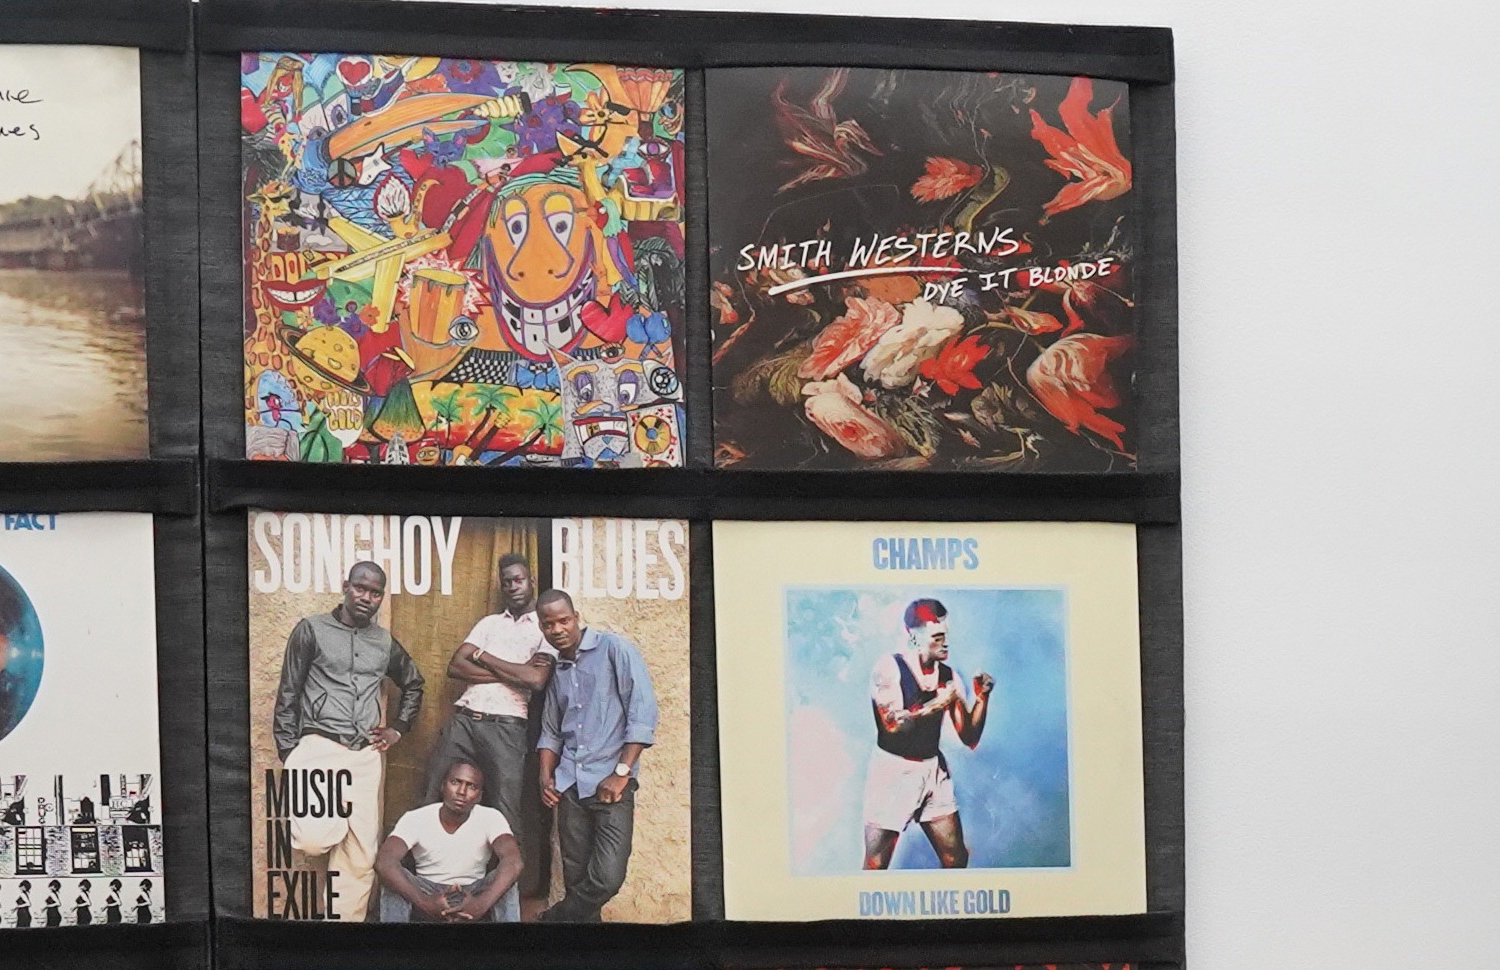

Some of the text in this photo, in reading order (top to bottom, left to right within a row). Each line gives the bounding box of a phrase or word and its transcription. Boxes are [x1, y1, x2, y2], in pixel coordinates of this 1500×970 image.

[737, 227, 1020, 272] SMITH WESTERNS
[924, 257, 1114, 305] DYE IT BLONDE
[4, 512, 60, 531] FACT
[254, 512, 685, 600] SONGHOY BLUES
[872, 537, 979, 570] CHAMPS
[265, 769, 352, 819] MUSIC
[266, 820, 292, 869] IN
[268, 870, 341, 920] EXILE
[859, 889, 1011, 917] DOWN LIKE GOLD
